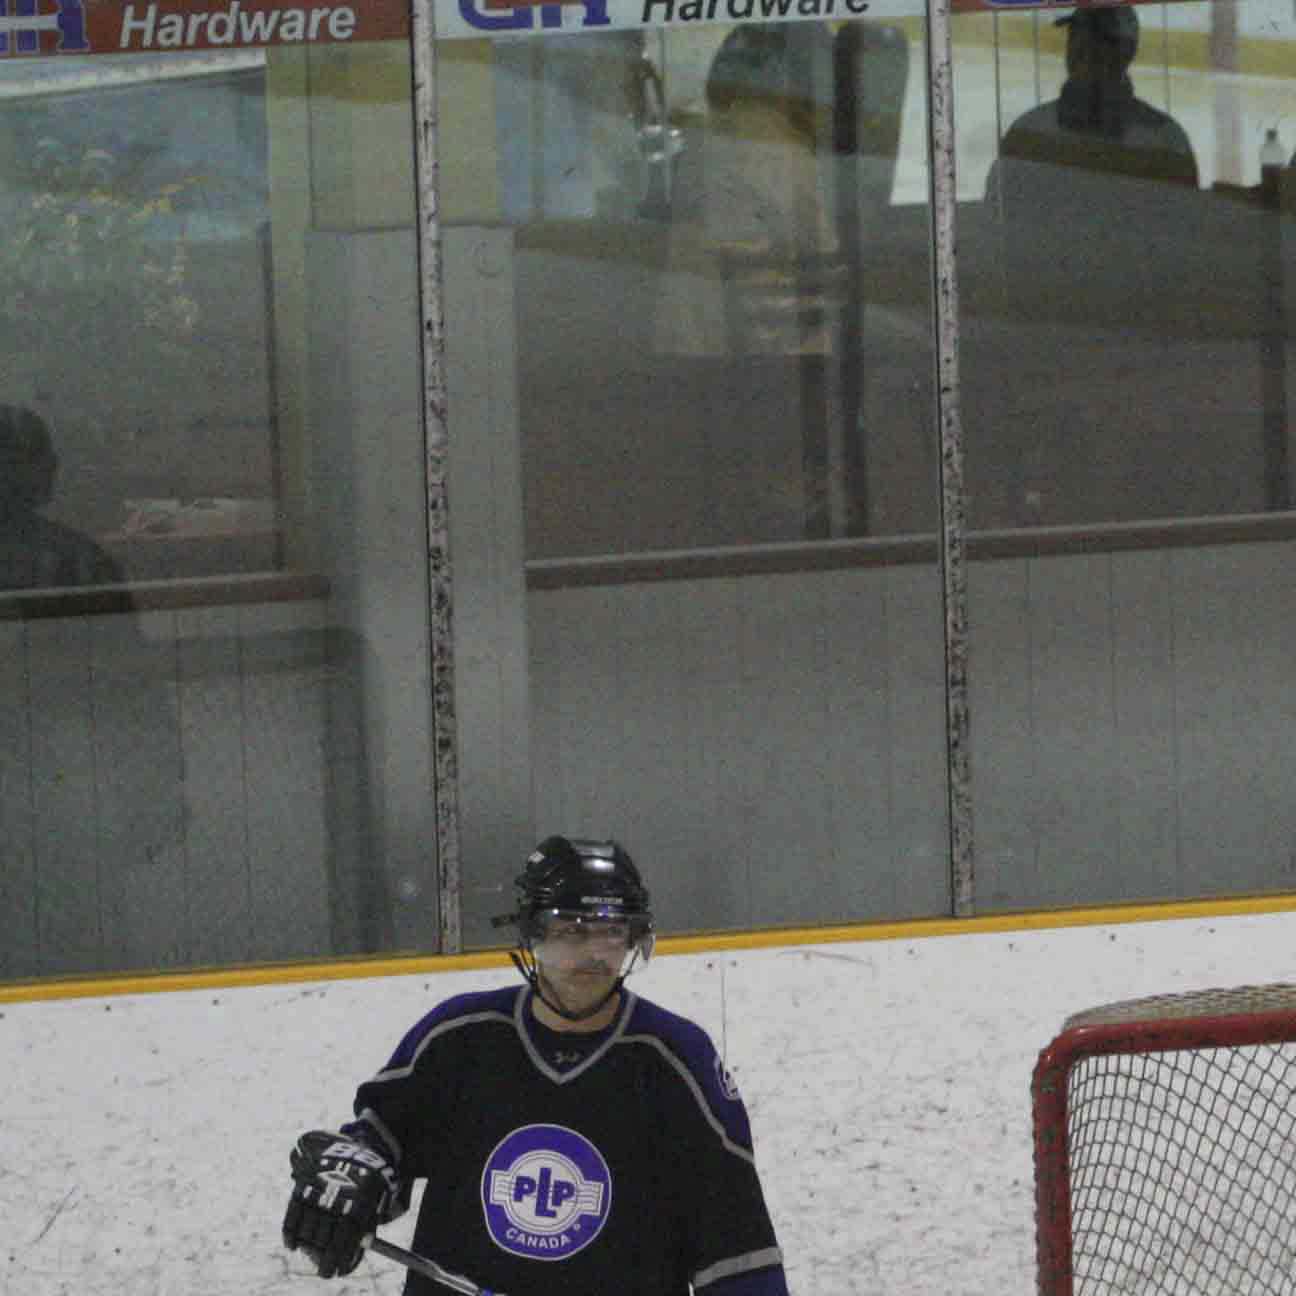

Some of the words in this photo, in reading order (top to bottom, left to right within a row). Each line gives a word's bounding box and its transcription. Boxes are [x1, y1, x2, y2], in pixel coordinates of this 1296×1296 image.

[119, 2, 356, 48] Hardware
[512, 1167, 576, 1217] PLP
[505, 1227, 571, 1249] CANADA
